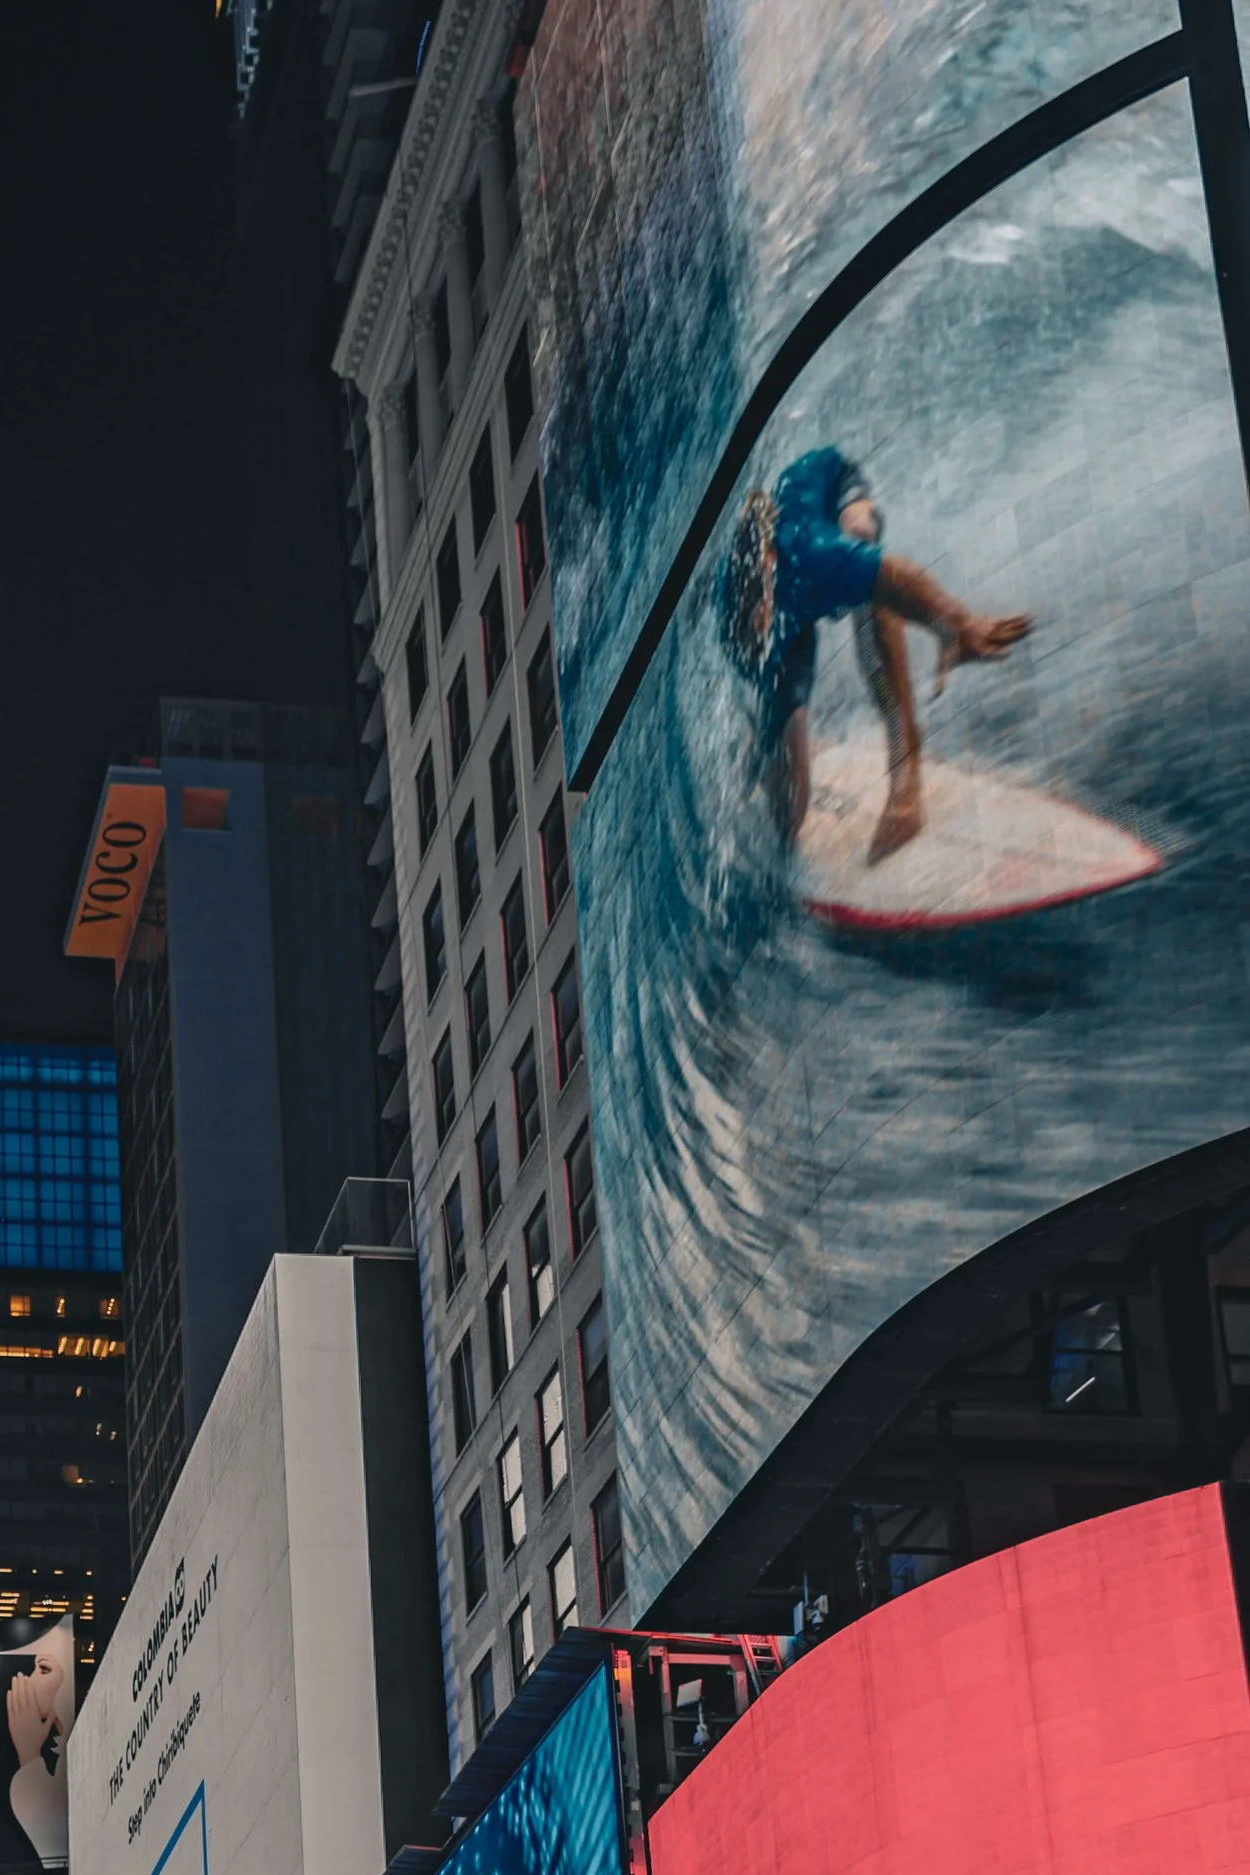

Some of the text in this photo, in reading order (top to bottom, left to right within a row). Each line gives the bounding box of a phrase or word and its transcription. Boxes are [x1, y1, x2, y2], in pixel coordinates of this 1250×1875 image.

[108, 1553, 219, 1805] THE COUNTRY OF BEAUTY
[131, 1590, 176, 1703] COLOMBIA
